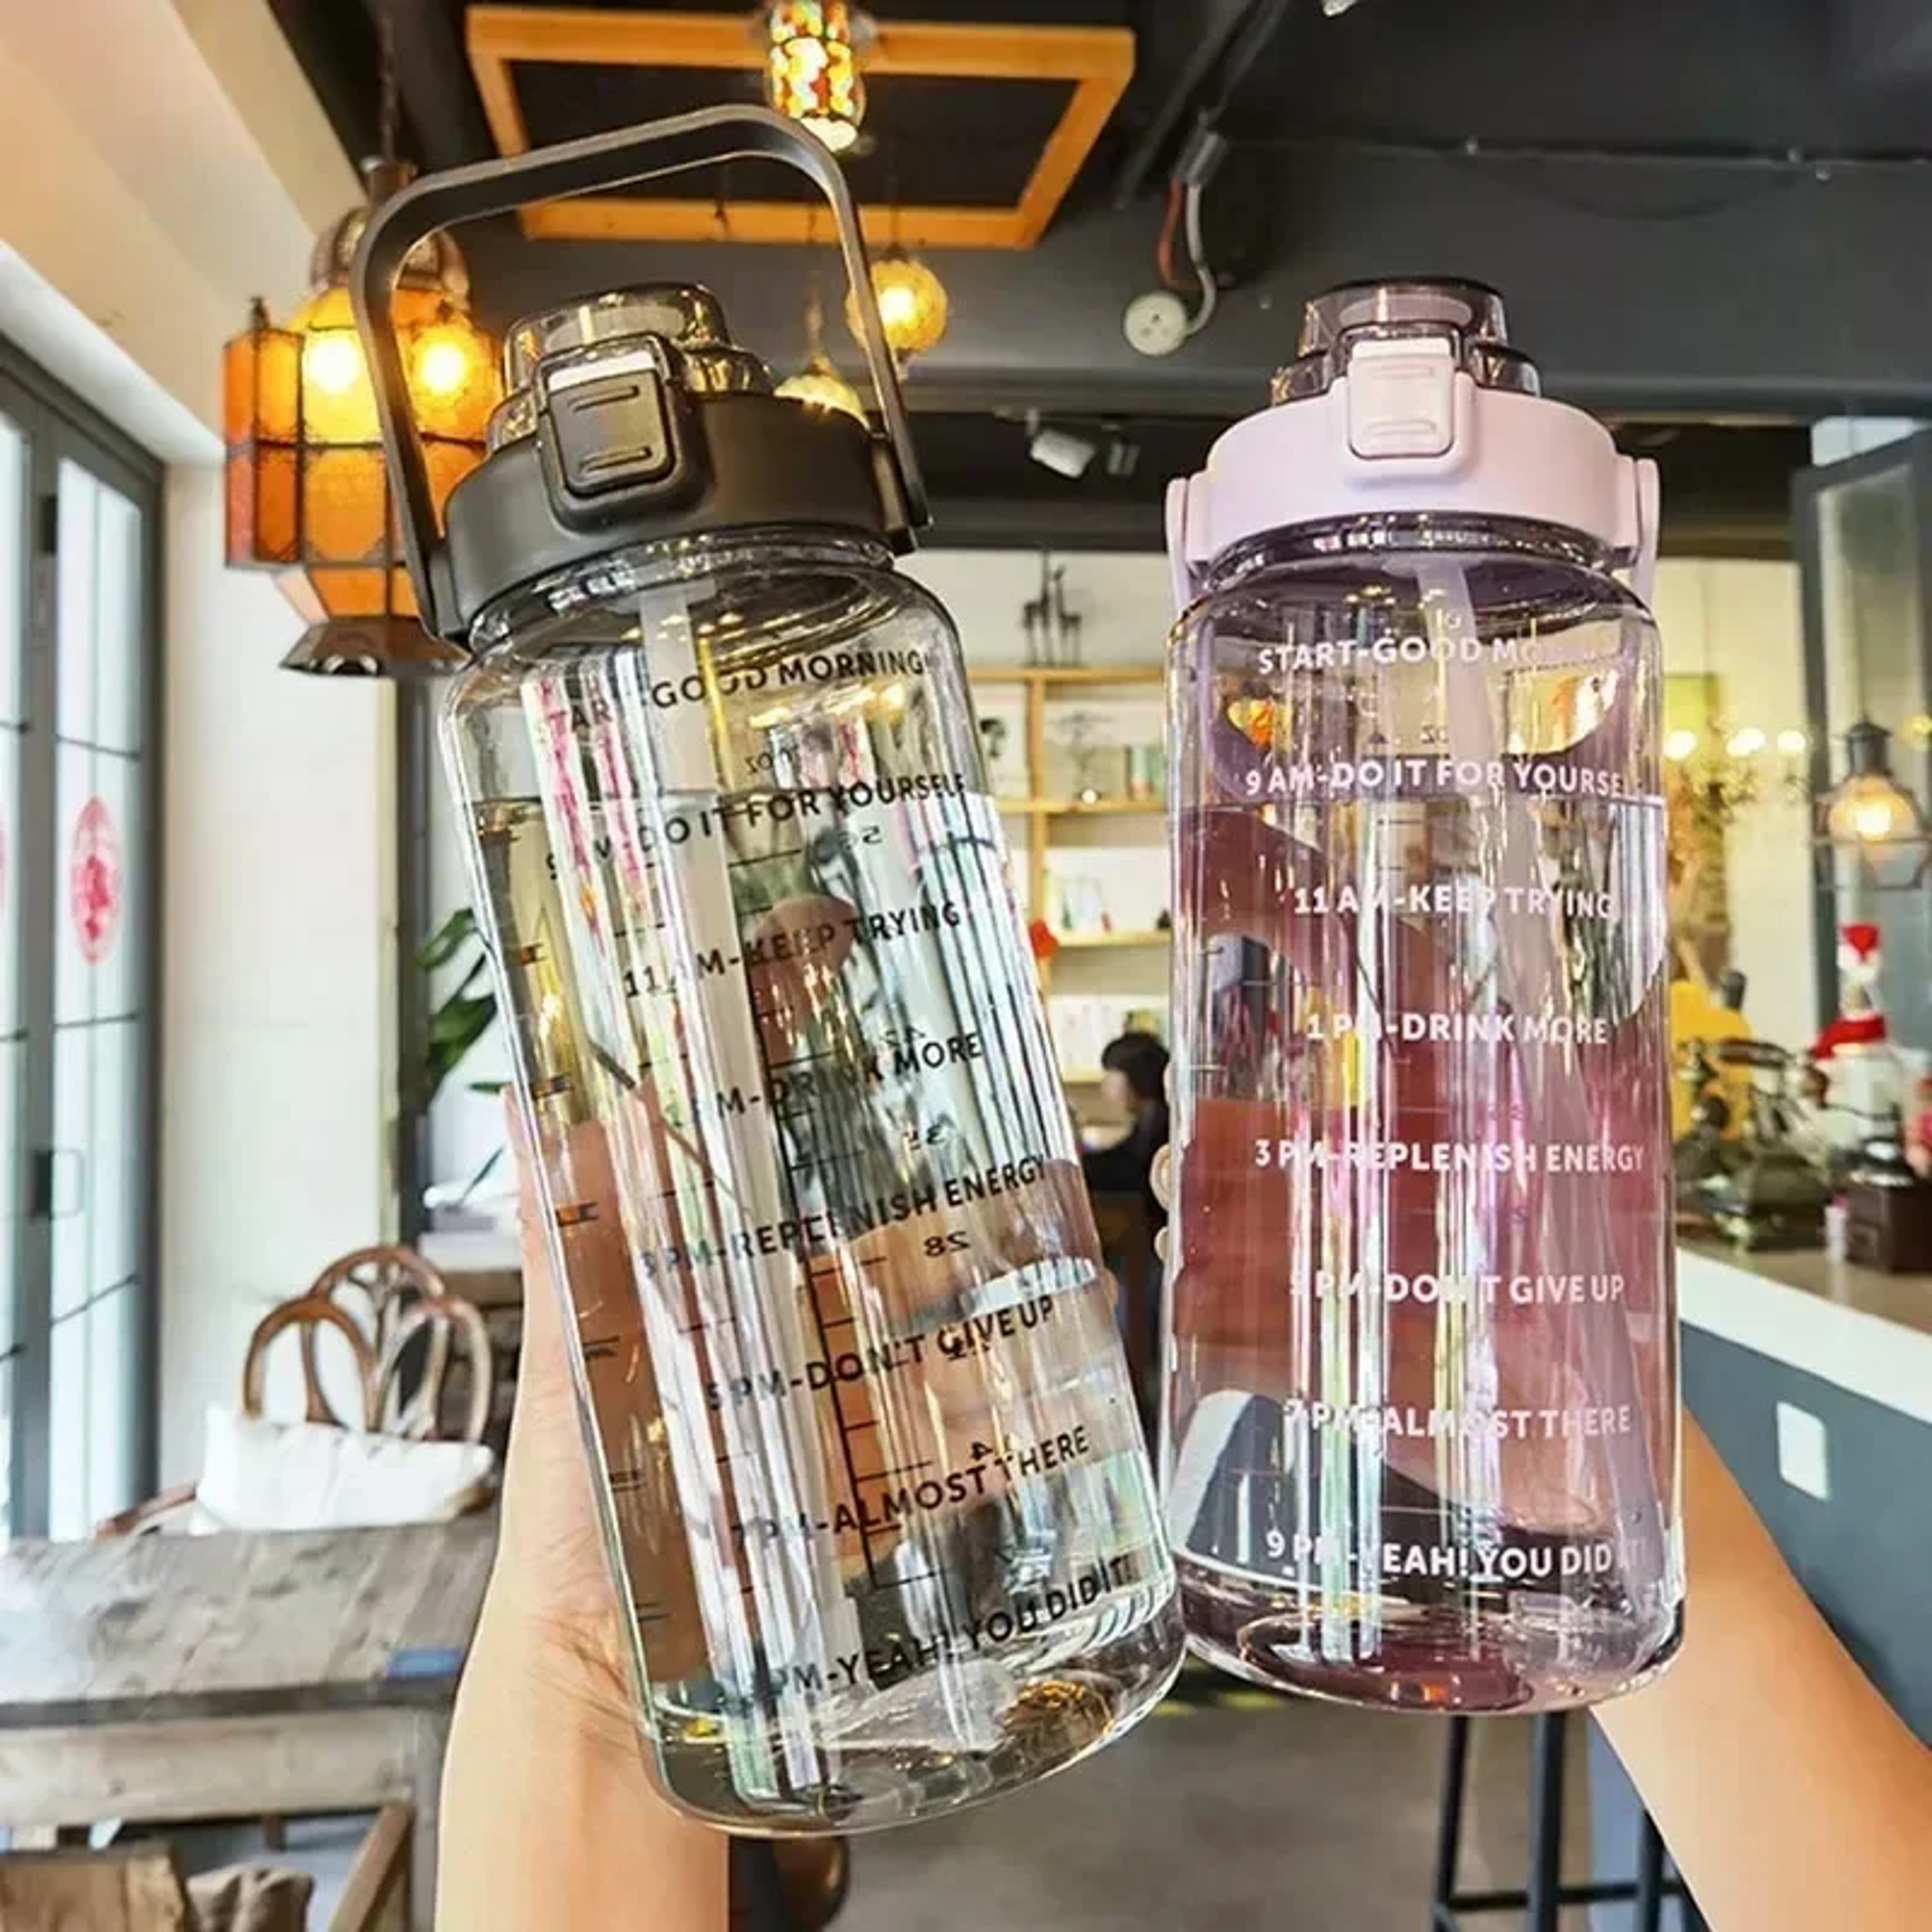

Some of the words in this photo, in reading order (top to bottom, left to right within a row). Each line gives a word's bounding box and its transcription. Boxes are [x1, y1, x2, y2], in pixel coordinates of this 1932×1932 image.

[1259, 636, 1482, 675] START-GOOD
[1245, 770, 1262, 796] 9
[1267, 760, 1384, 794] AM-DO
[1394, 759, 1427, 786] IT
[1436, 759, 1505, 786] FOR
[746, 789, 822, 828] FOR
[825, 773, 966, 816] YOURSELF
[1294, 887, 1329, 914] 11
[1504, 887, 1613, 919] TRYING
[663, 924, 835, 995] M-KEEP
[842, 901, 960, 945] TRYING
[1307, 1014, 1324, 1039] 1
[1523, 1015, 1608, 1045] MORE
[894, 1032, 982, 1076] MORE
[1255, 1139, 1271, 1167] 3
[1546, 1144, 1644, 1173] ENERGY
[944, 1153, 1046, 1208] ENERGY
[1509, 1274, 1585, 1305] GIVE
[1590, 1273, 1625, 1303] UP
[936, 1306, 1015, 1354] GIVE
[1017, 1294, 1055, 1329] UP
[1539, 1404, 1632, 1439] THERE
[994, 1424, 1089, 1481] THERE
[1266, 1530, 1286, 1559] 9
[1477, 1546, 1552, 1578] YOU
[1561, 1543, 1613, 1575] DID
[961, 1602, 1037, 1650] YOU
